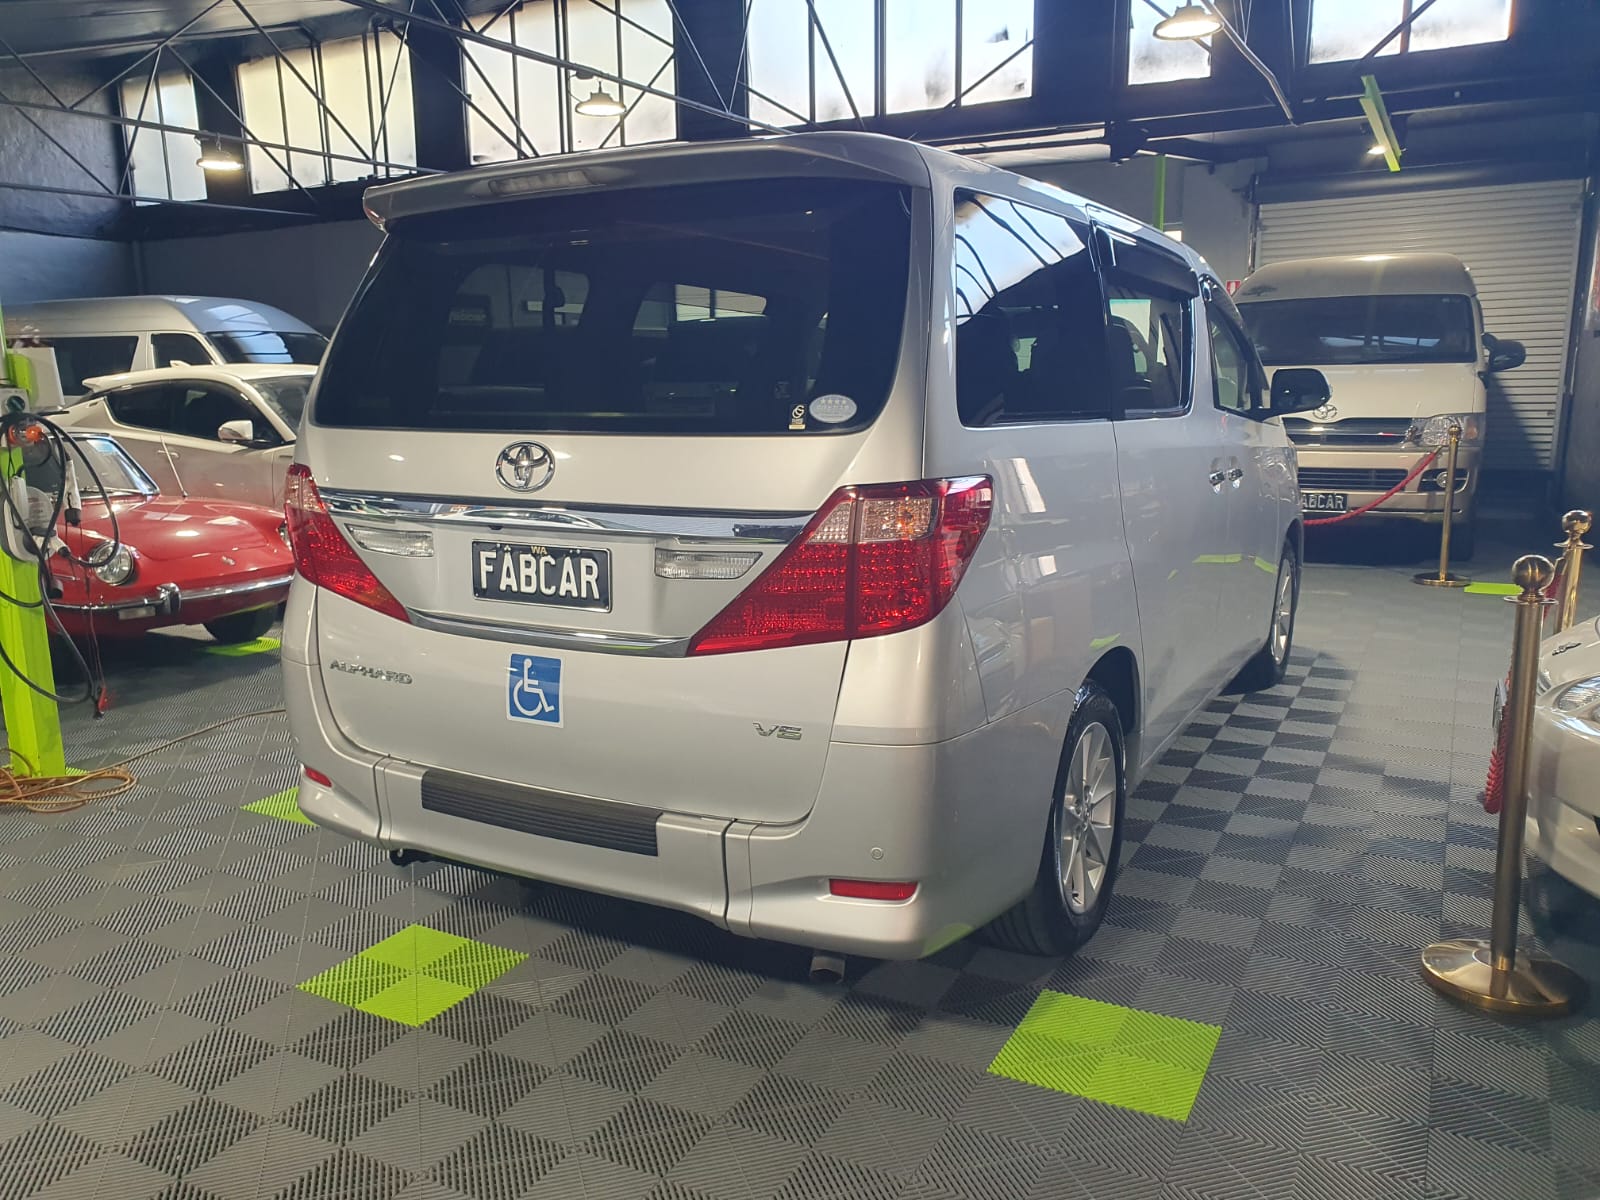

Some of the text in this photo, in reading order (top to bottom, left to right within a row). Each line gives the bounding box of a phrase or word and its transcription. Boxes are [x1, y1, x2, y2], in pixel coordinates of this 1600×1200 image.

[531, 545, 548, 555] WA
[480, 550, 599, 599] FABCAR
[330, 660, 413, 684] ALPHARD
